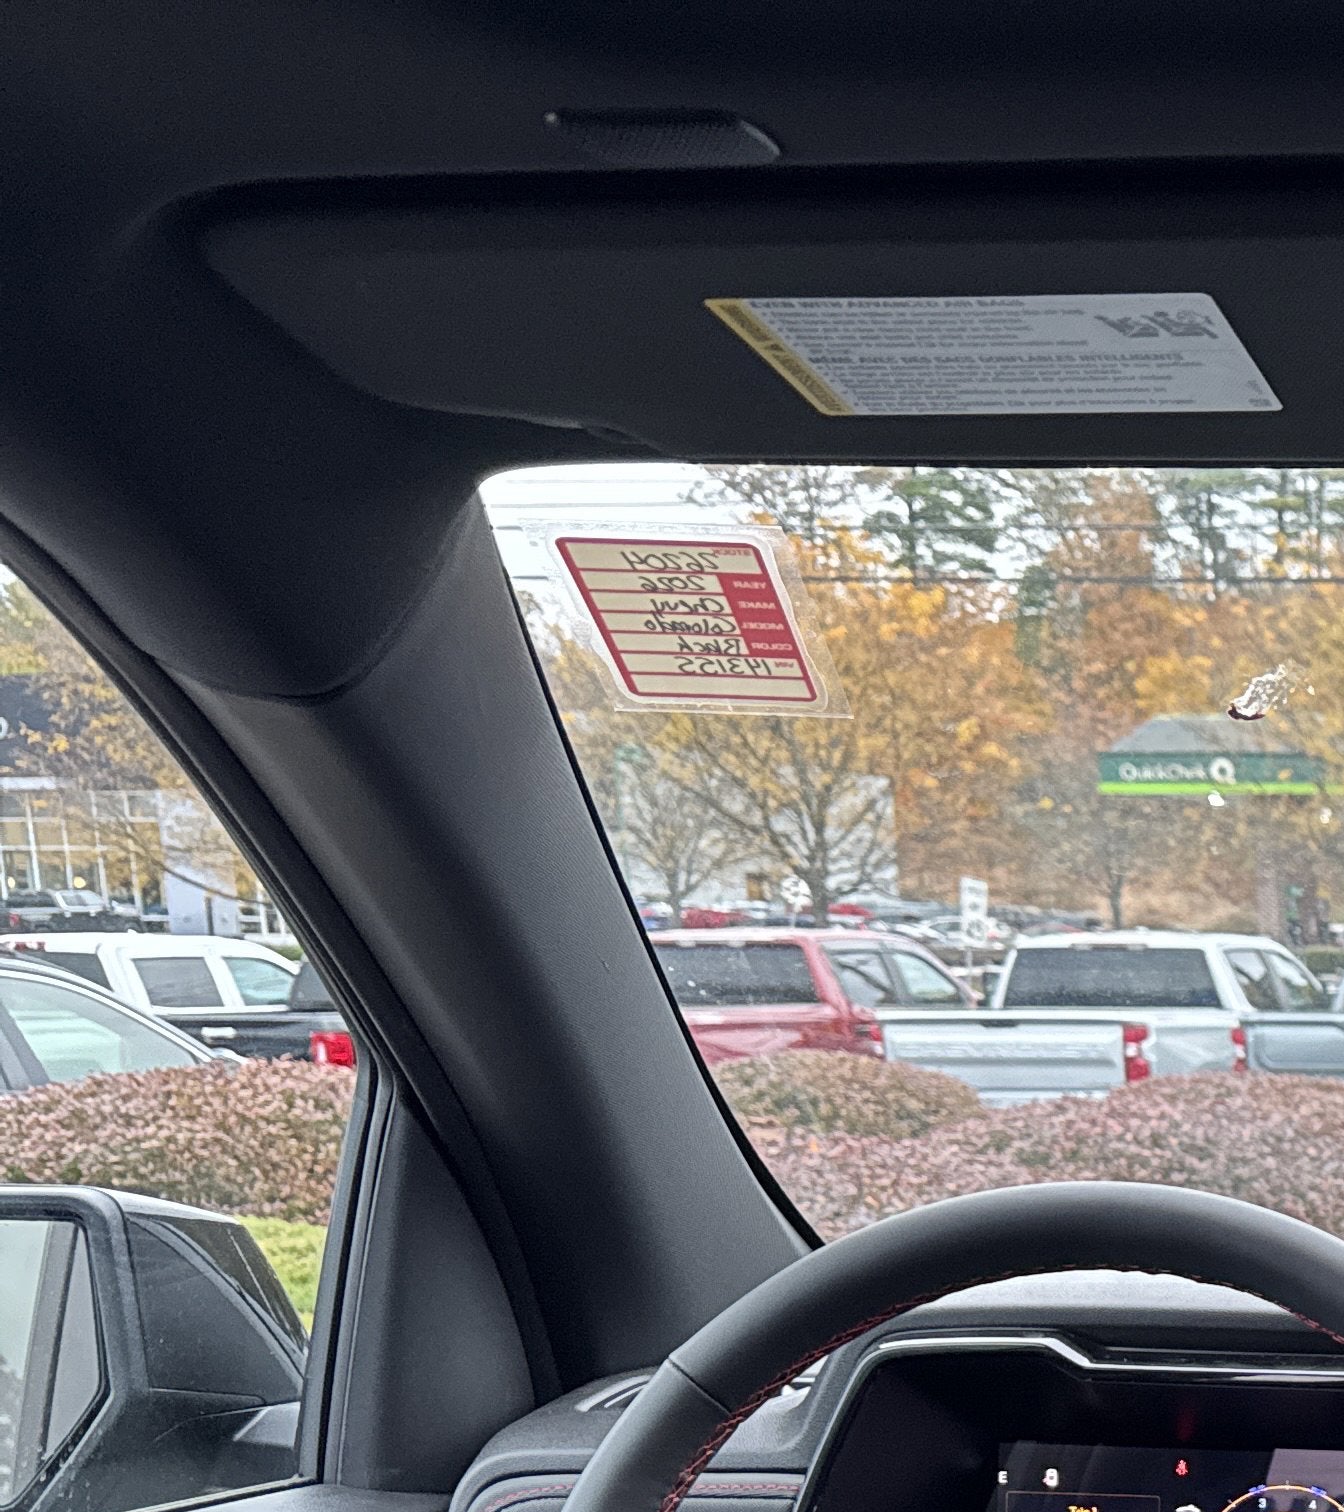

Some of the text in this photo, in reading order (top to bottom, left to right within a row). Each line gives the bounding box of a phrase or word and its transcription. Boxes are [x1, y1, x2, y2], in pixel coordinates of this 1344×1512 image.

[997, 1470, 1008, 1485] E
[1258, 1498, 1267, 1509] 3
[1308, 1499, 1318, 1510] 4
